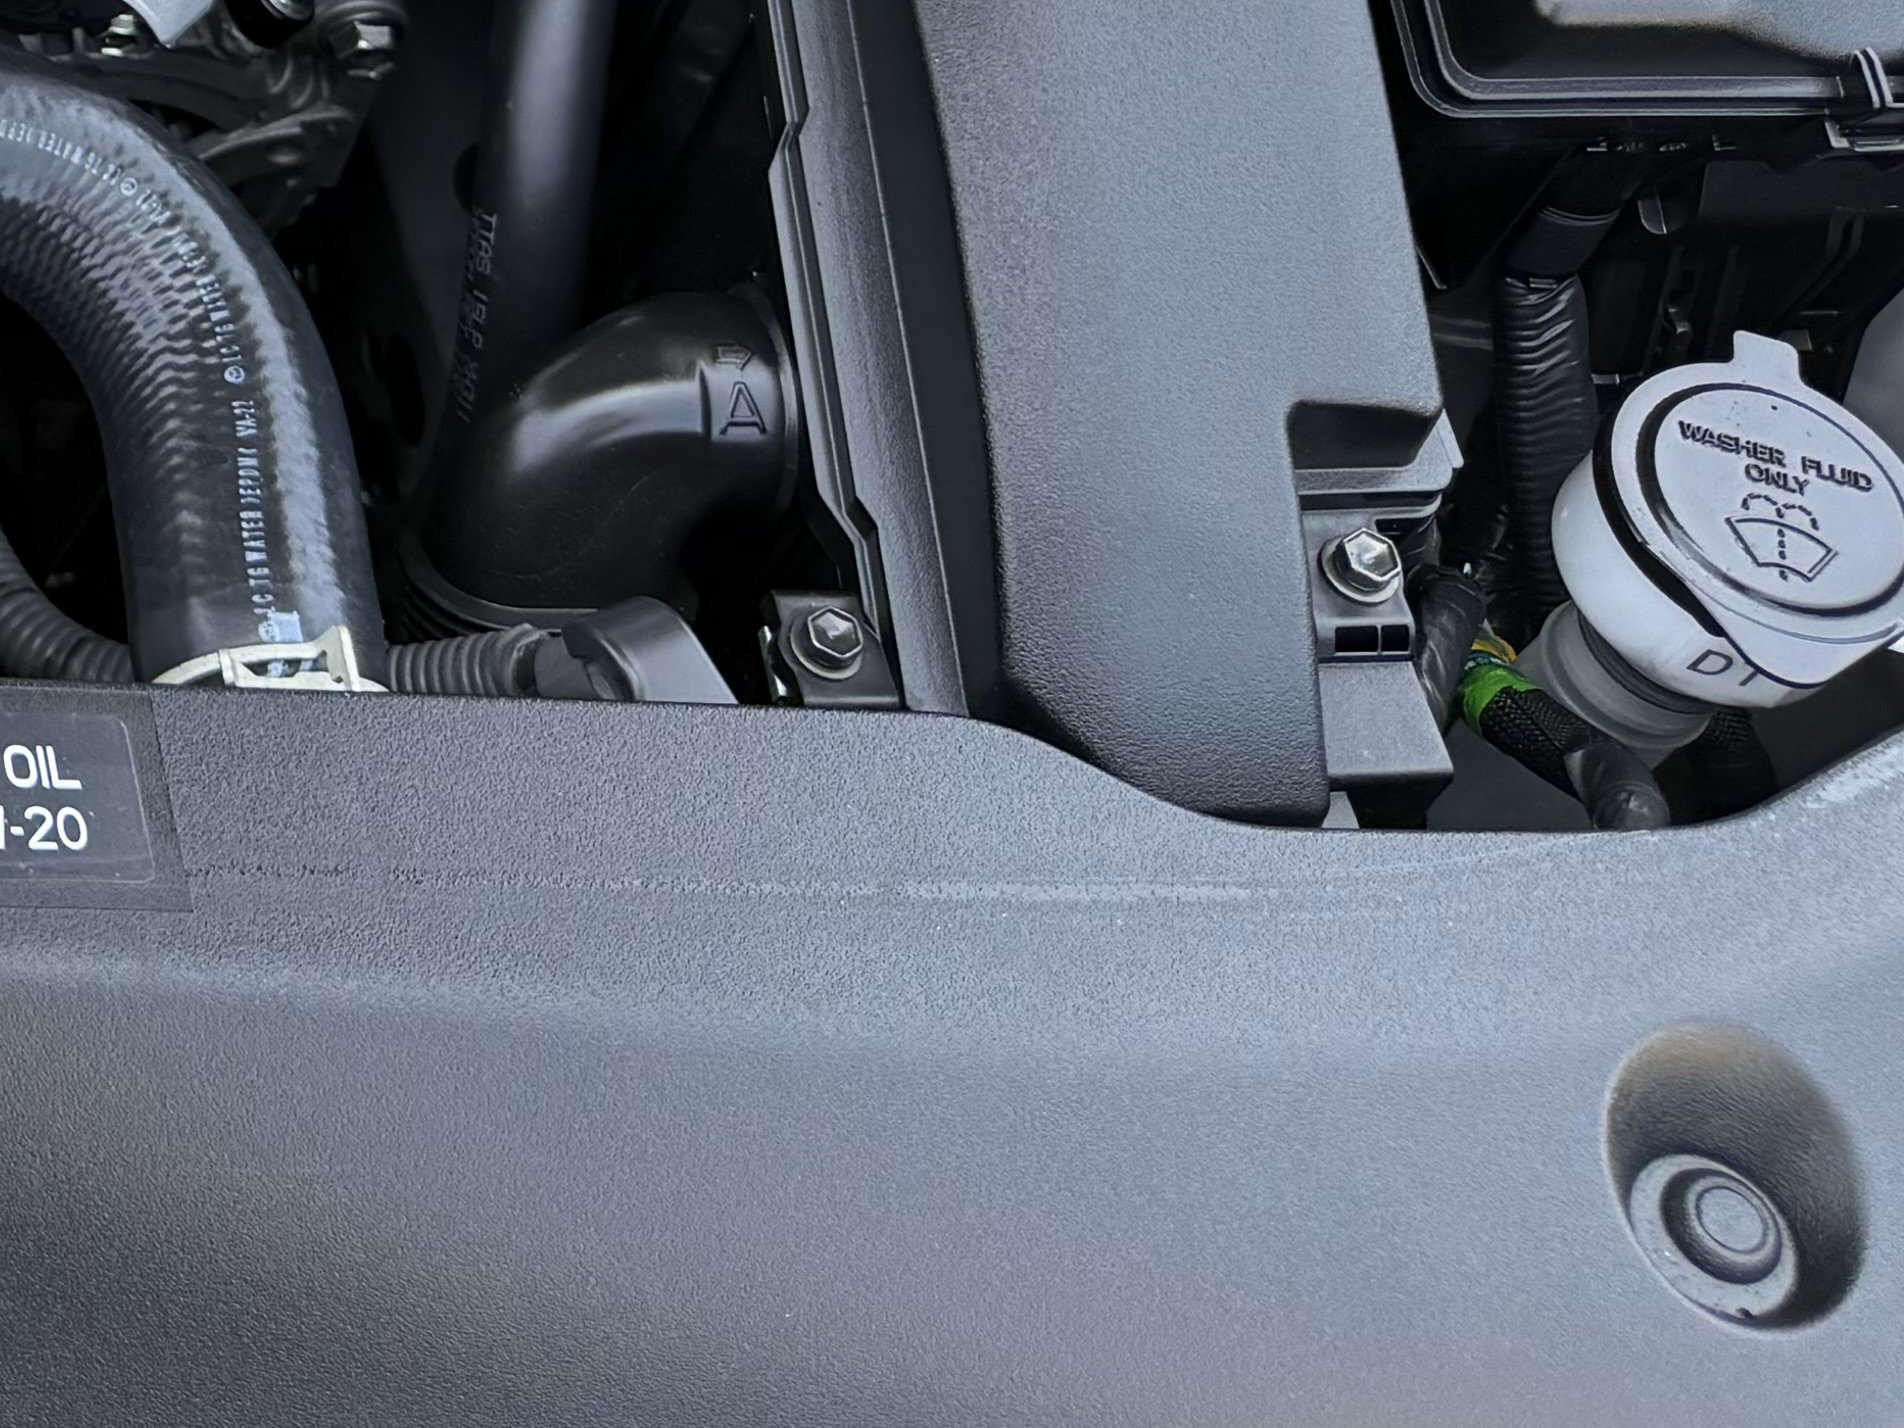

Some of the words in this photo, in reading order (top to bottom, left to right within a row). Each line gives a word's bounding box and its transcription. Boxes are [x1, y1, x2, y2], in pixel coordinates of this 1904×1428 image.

[719, 381, 768, 436] A
[1678, 420, 1787, 468] WASHER
[1800, 455, 1875, 494] FLUID
[1744, 462, 1811, 496] ONLY
[239, 510, 269, 564] WATER
[3, 744, 83, 790] OIL
